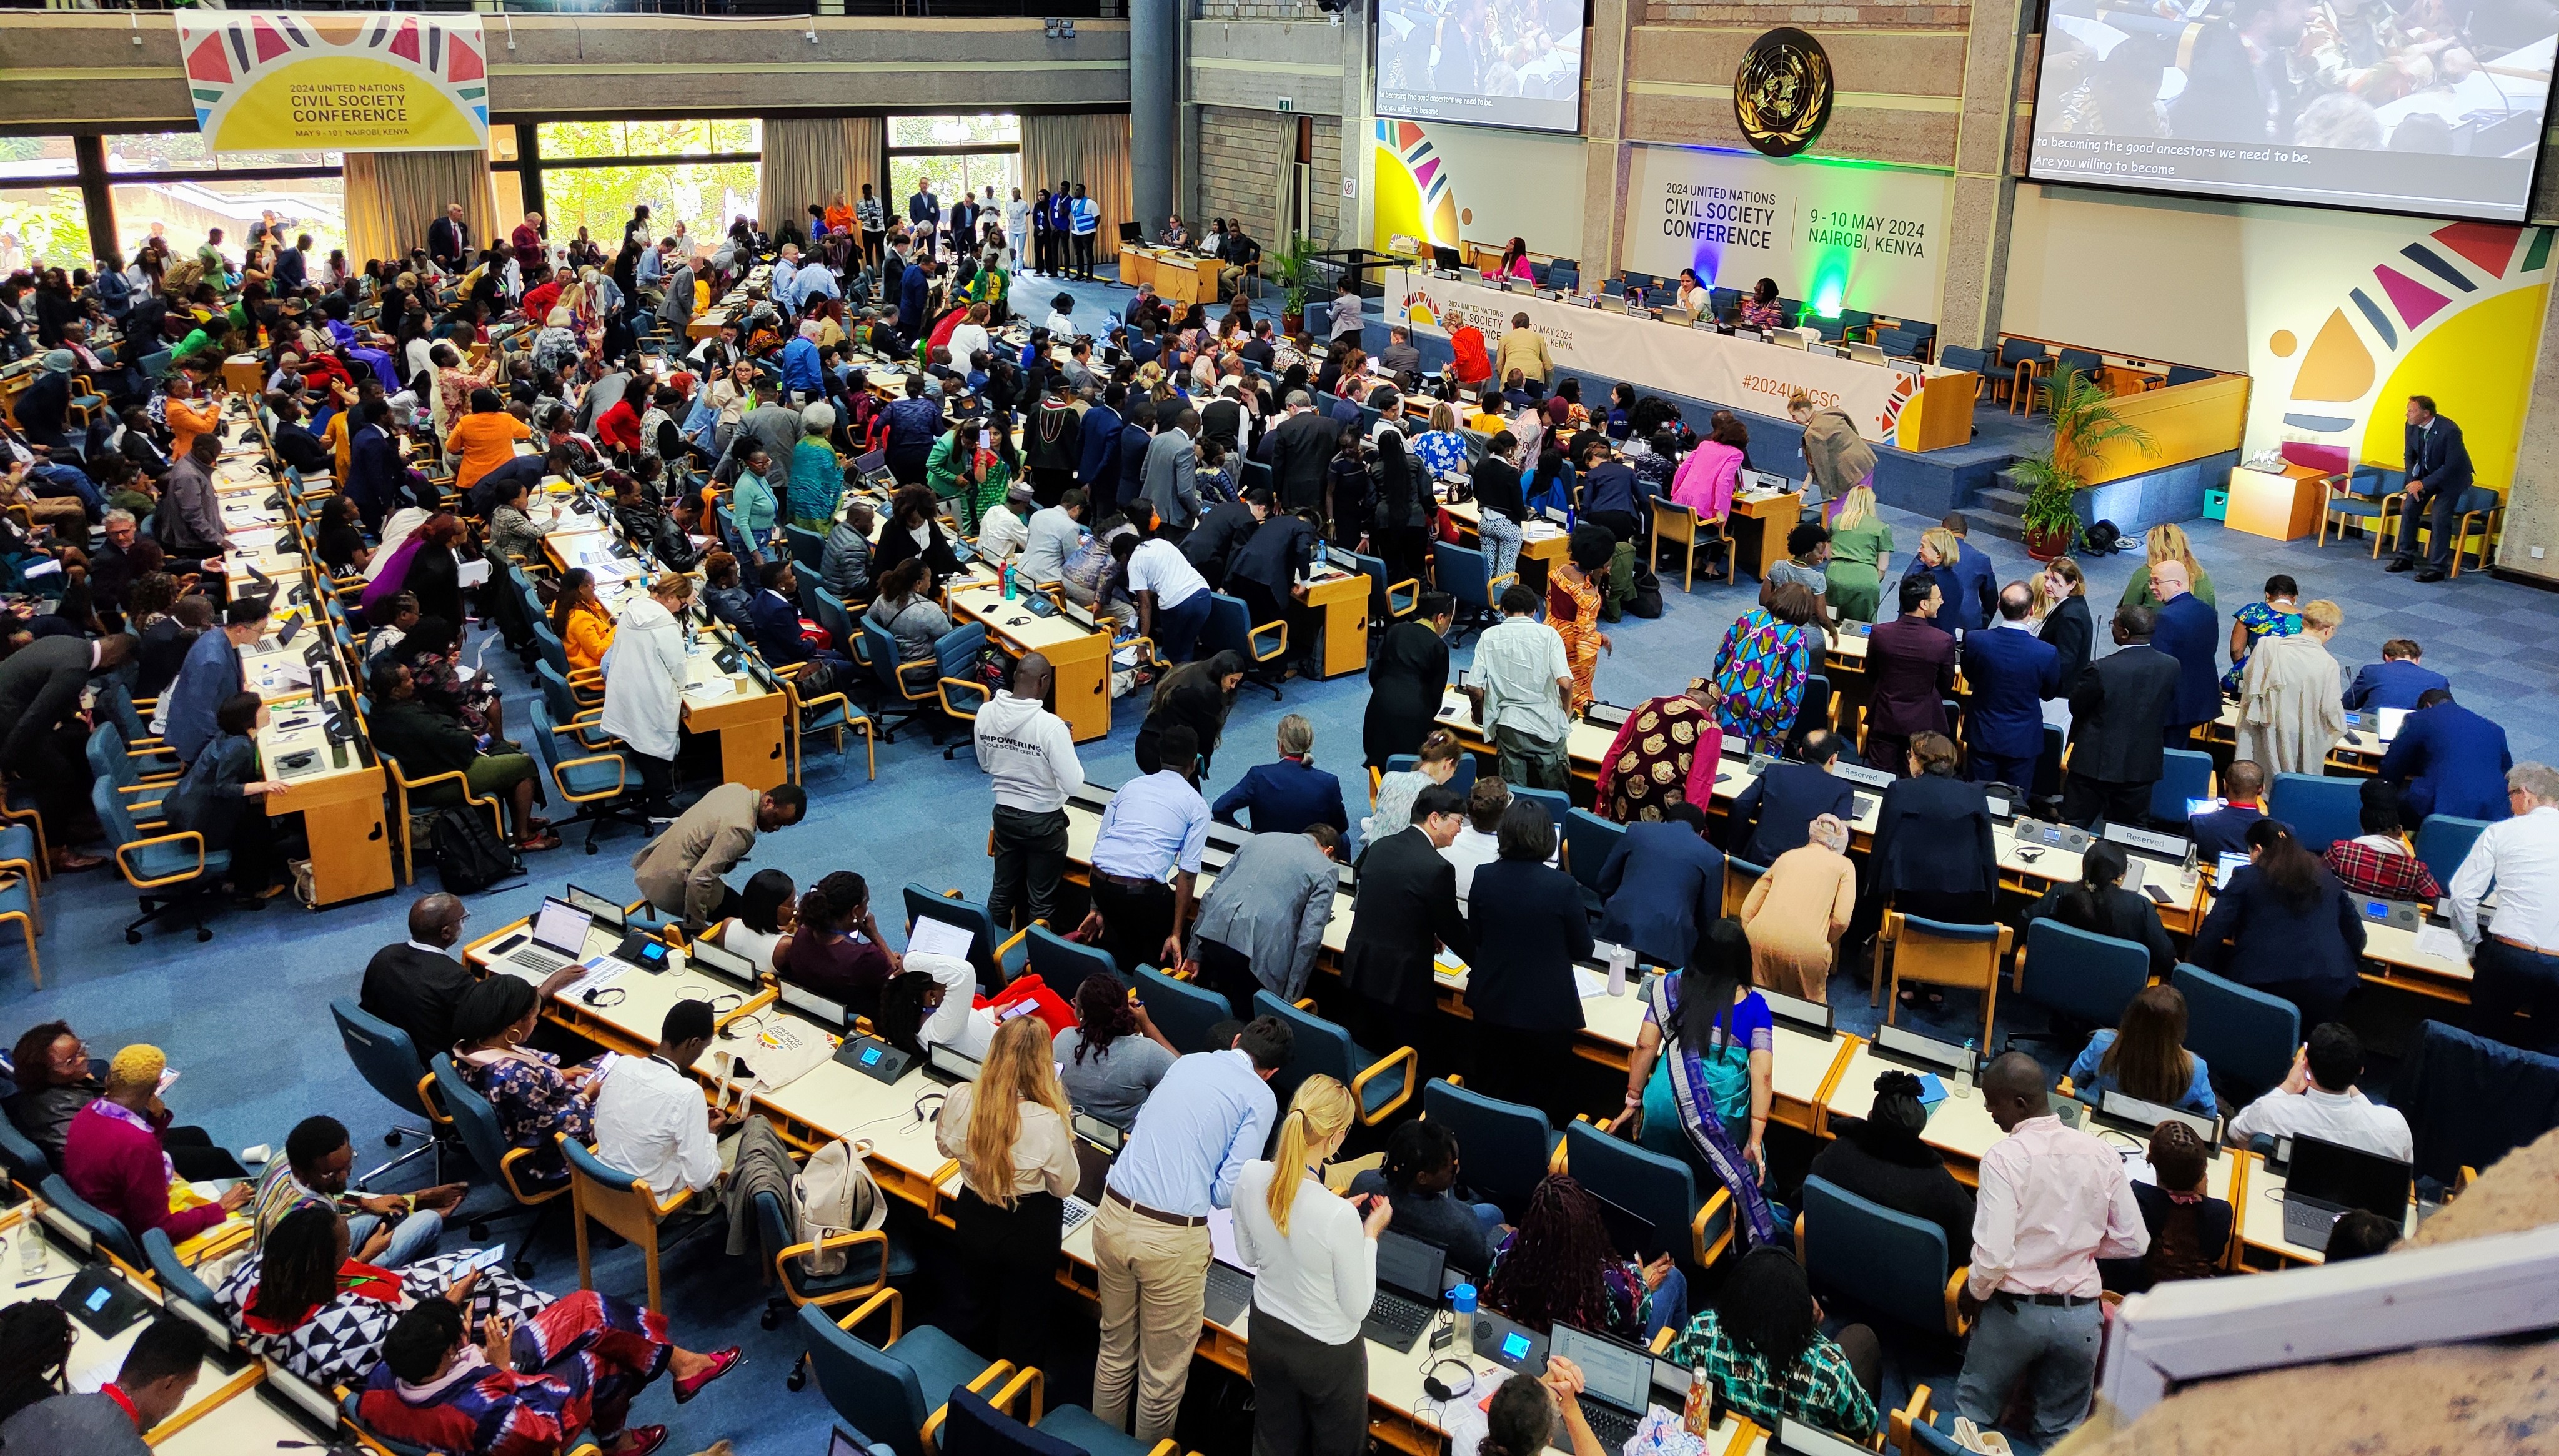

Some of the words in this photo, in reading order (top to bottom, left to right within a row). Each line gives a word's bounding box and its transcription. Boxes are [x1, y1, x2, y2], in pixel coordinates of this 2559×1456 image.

[290, 84, 314, 92] 2024
[317, 84, 356, 92] UNITED
[359, 84, 405, 92] NATIONS
[291, 95, 334, 107] CIVIL
[338, 94, 405, 107] SOCIETY
[1408, 92, 1416, 101] the
[1417, 93, 1429, 103] good
[1430, 95, 1454, 104] ancestors
[1463, 97, 1476, 105] need
[293, 109, 408, 122] CONFERENCE
[2036, 136, 2048, 147] to
[2051, 136, 2101, 153] becoming
[2104, 139, 2123, 151] the
[2125, 142, 2154, 156] good
[2157, 145, 2216, 157] ancestors
[2219, 149, 2236, 159] we
[2239, 149, 2270, 161] need
[2274, 151, 2288, 162] to
[2292, 150, 2312, 164] be.
[2034, 154, 2054, 166] Are
[2057, 158, 2076, 170] you
[2079, 157, 2112, 174] willing
[2115, 161, 2127, 171] to
[2131, 161, 2175, 175] become
[1666, 182, 1688, 195] 2024
[1691, 185, 1726, 199] UNITED
[1729, 189, 1776, 206] NATIONS
[1665, 197, 1702, 217] CIVIL
[1706, 202, 1775, 226] SOCIETY
[1811, 209, 1818, 223] 9
[1831, 211, 1847, 227] 10
[1852, 214, 1886, 232] MAY
[1889, 219, 1925, 239] 2024
[1664, 219, 1772, 250] CONFERENCE
[1809, 227, 1871, 253] NAIROBI,
[1875, 237, 1924, 259] KENYA
[1448, 300, 1460, 309] 2024
[1461, 302, 1479, 312] UNITED
[1480, 307, 1503, 318] NATIONS
[1469, 313, 1503, 329] SOCIETY
[1539, 325, 1554, 336] MAY
[1556, 329, 1573, 340] 2024
[1551, 338, 1573, 351] KENYA
[1605, 710, 1626, 721] Reserv
[980, 734, 1042, 753] EMPOWERING
[1845, 768, 1877, 781] Reserved
[2126, 832, 2165, 848] Reserved
